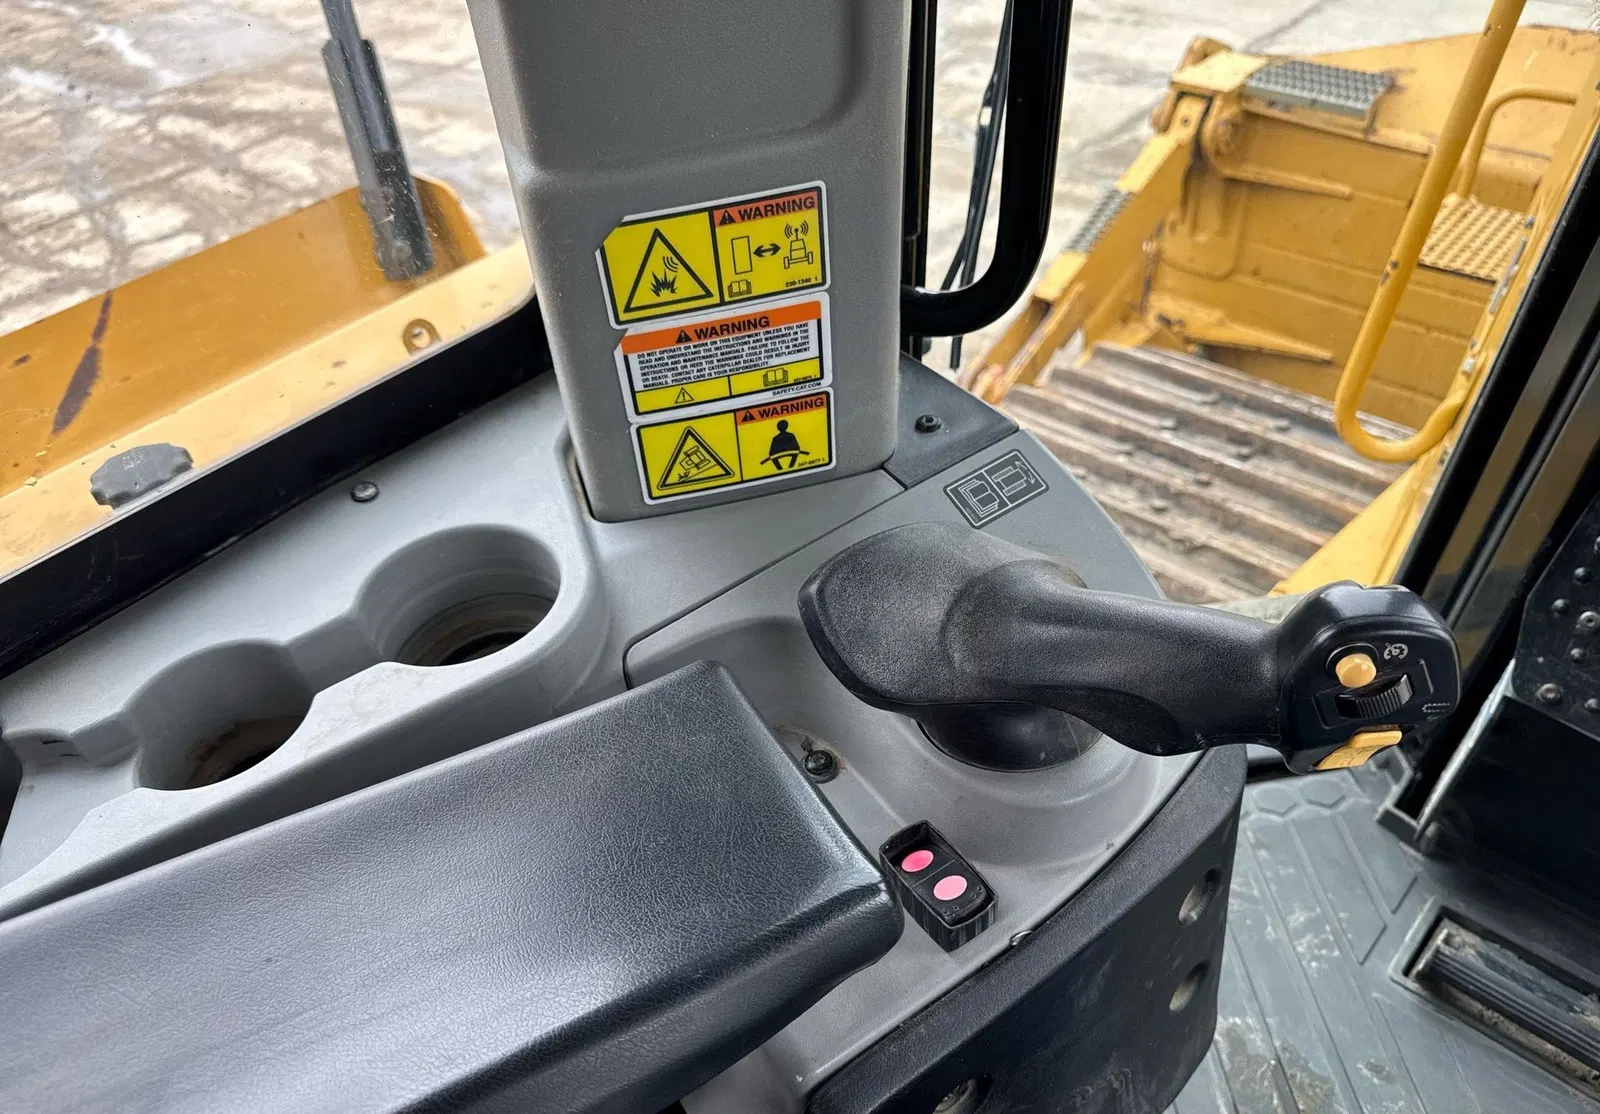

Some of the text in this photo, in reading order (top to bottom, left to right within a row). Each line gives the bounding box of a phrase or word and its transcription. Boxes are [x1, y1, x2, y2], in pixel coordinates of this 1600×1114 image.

[738, 197, 815, 221] WARNING
[694, 316, 770, 340] WARNING
[659, 347, 681, 355] OPERATE
[693, 341, 708, 349] WORK
[732, 332, 761, 341] EQUIPMENT
[763, 327, 782, 335] UNLESS
[667, 350, 701, 360] UNDERSTAND
[714, 341, 750, 350] INSTRUCTIONS
[764, 333, 791, 342] WARNINGS
[640, 362, 669, 370] OPERATION
[683, 353, 716, 363] MAINTENANCE
[720, 348, 746, 356] MANUALS.
[641, 367, 679, 376] INSTRUCTIONS
[717, 353, 743, 362] WARNINGS
[708, 361, 740, 371] CATERPILLAR
[775, 347, 810, 358] REPLACEMENT
[643, 380, 670, 388] MANUALS.
[672, 376, 691, 384] PROPER
[729, 362, 770, 372] RESPONSIBILITY.
[772, 382, 821, 396] SAFETY.CAT.COM
[758, 397, 824, 419] WARNING
